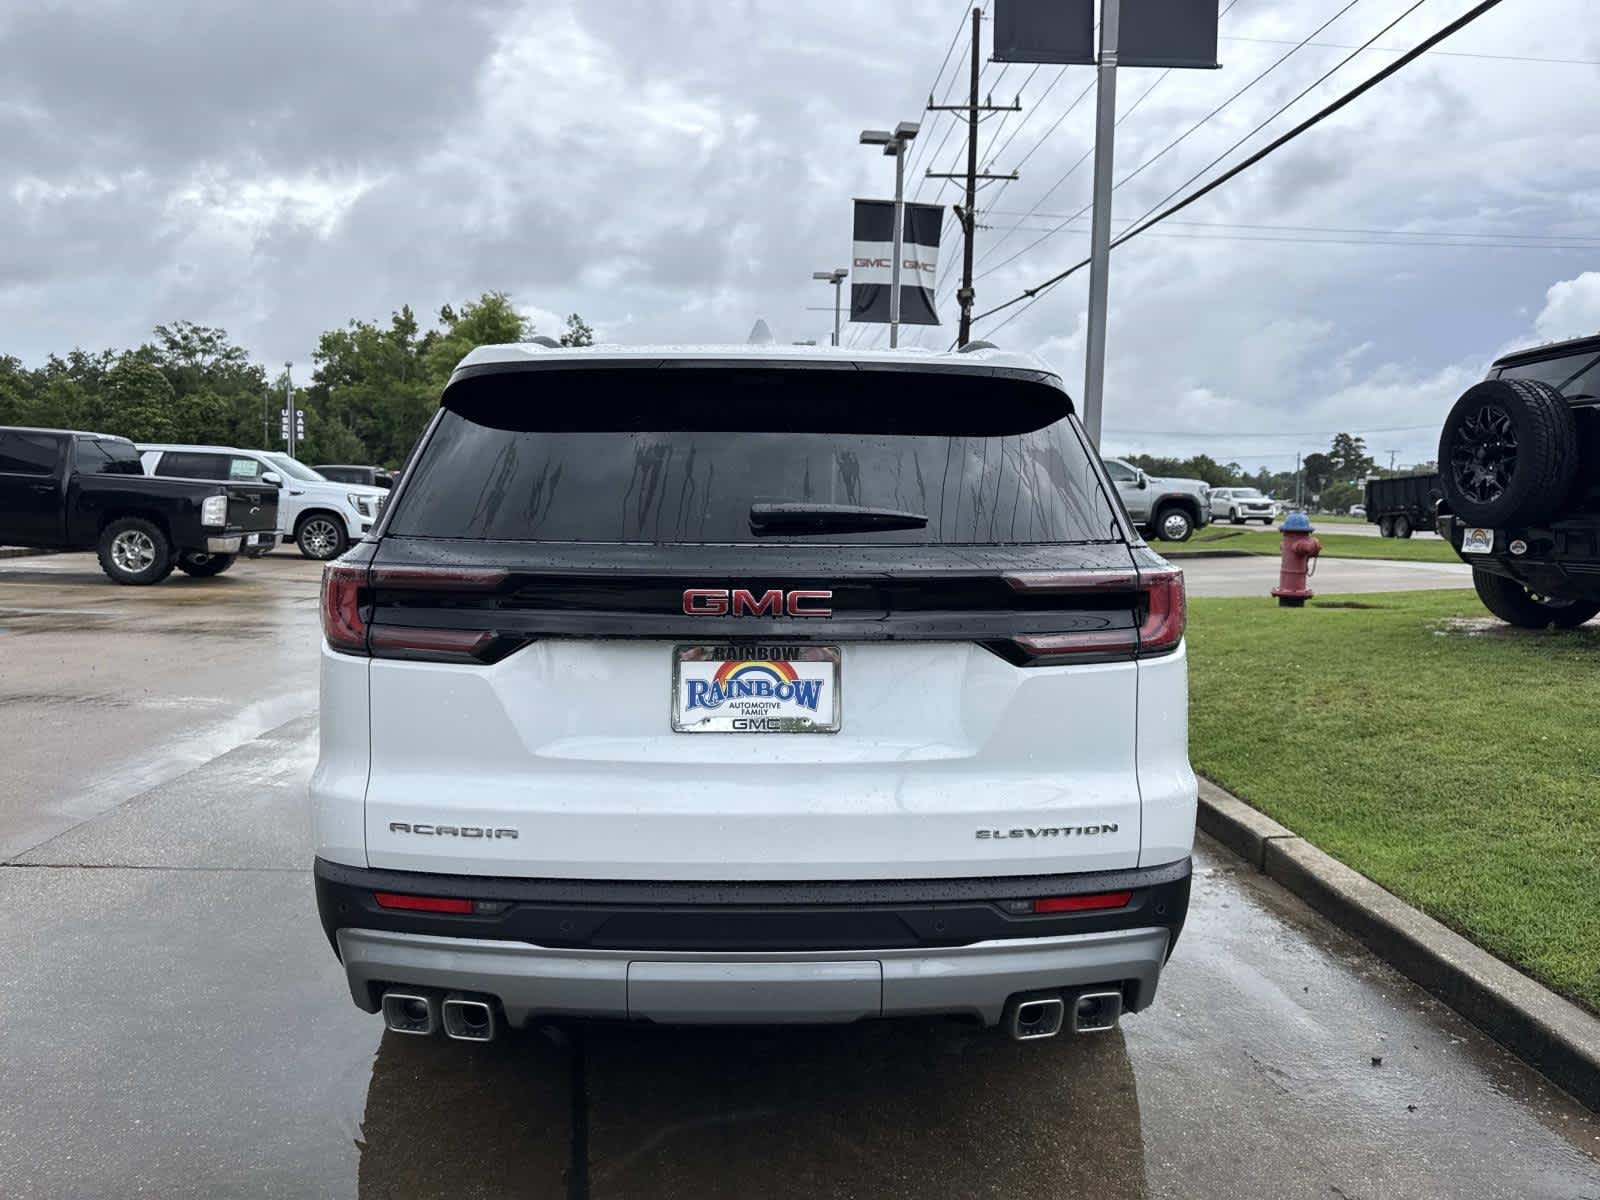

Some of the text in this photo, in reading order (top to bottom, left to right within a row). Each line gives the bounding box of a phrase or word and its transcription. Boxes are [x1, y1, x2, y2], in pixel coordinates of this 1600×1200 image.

[854, 258, 892, 268] GMC
[903, 260, 936, 273] GMC
[281, 409, 289, 440] USED
[296, 410, 305, 440] CARS
[682, 589, 833, 617] GMC
[712, 647, 801, 661] RAINBOW
[686, 678, 825, 712] RAINBOW
[732, 719, 781, 730] GMC
[389, 822, 519, 839] ACADIA
[975, 823, 1119, 839] ELEVATION
